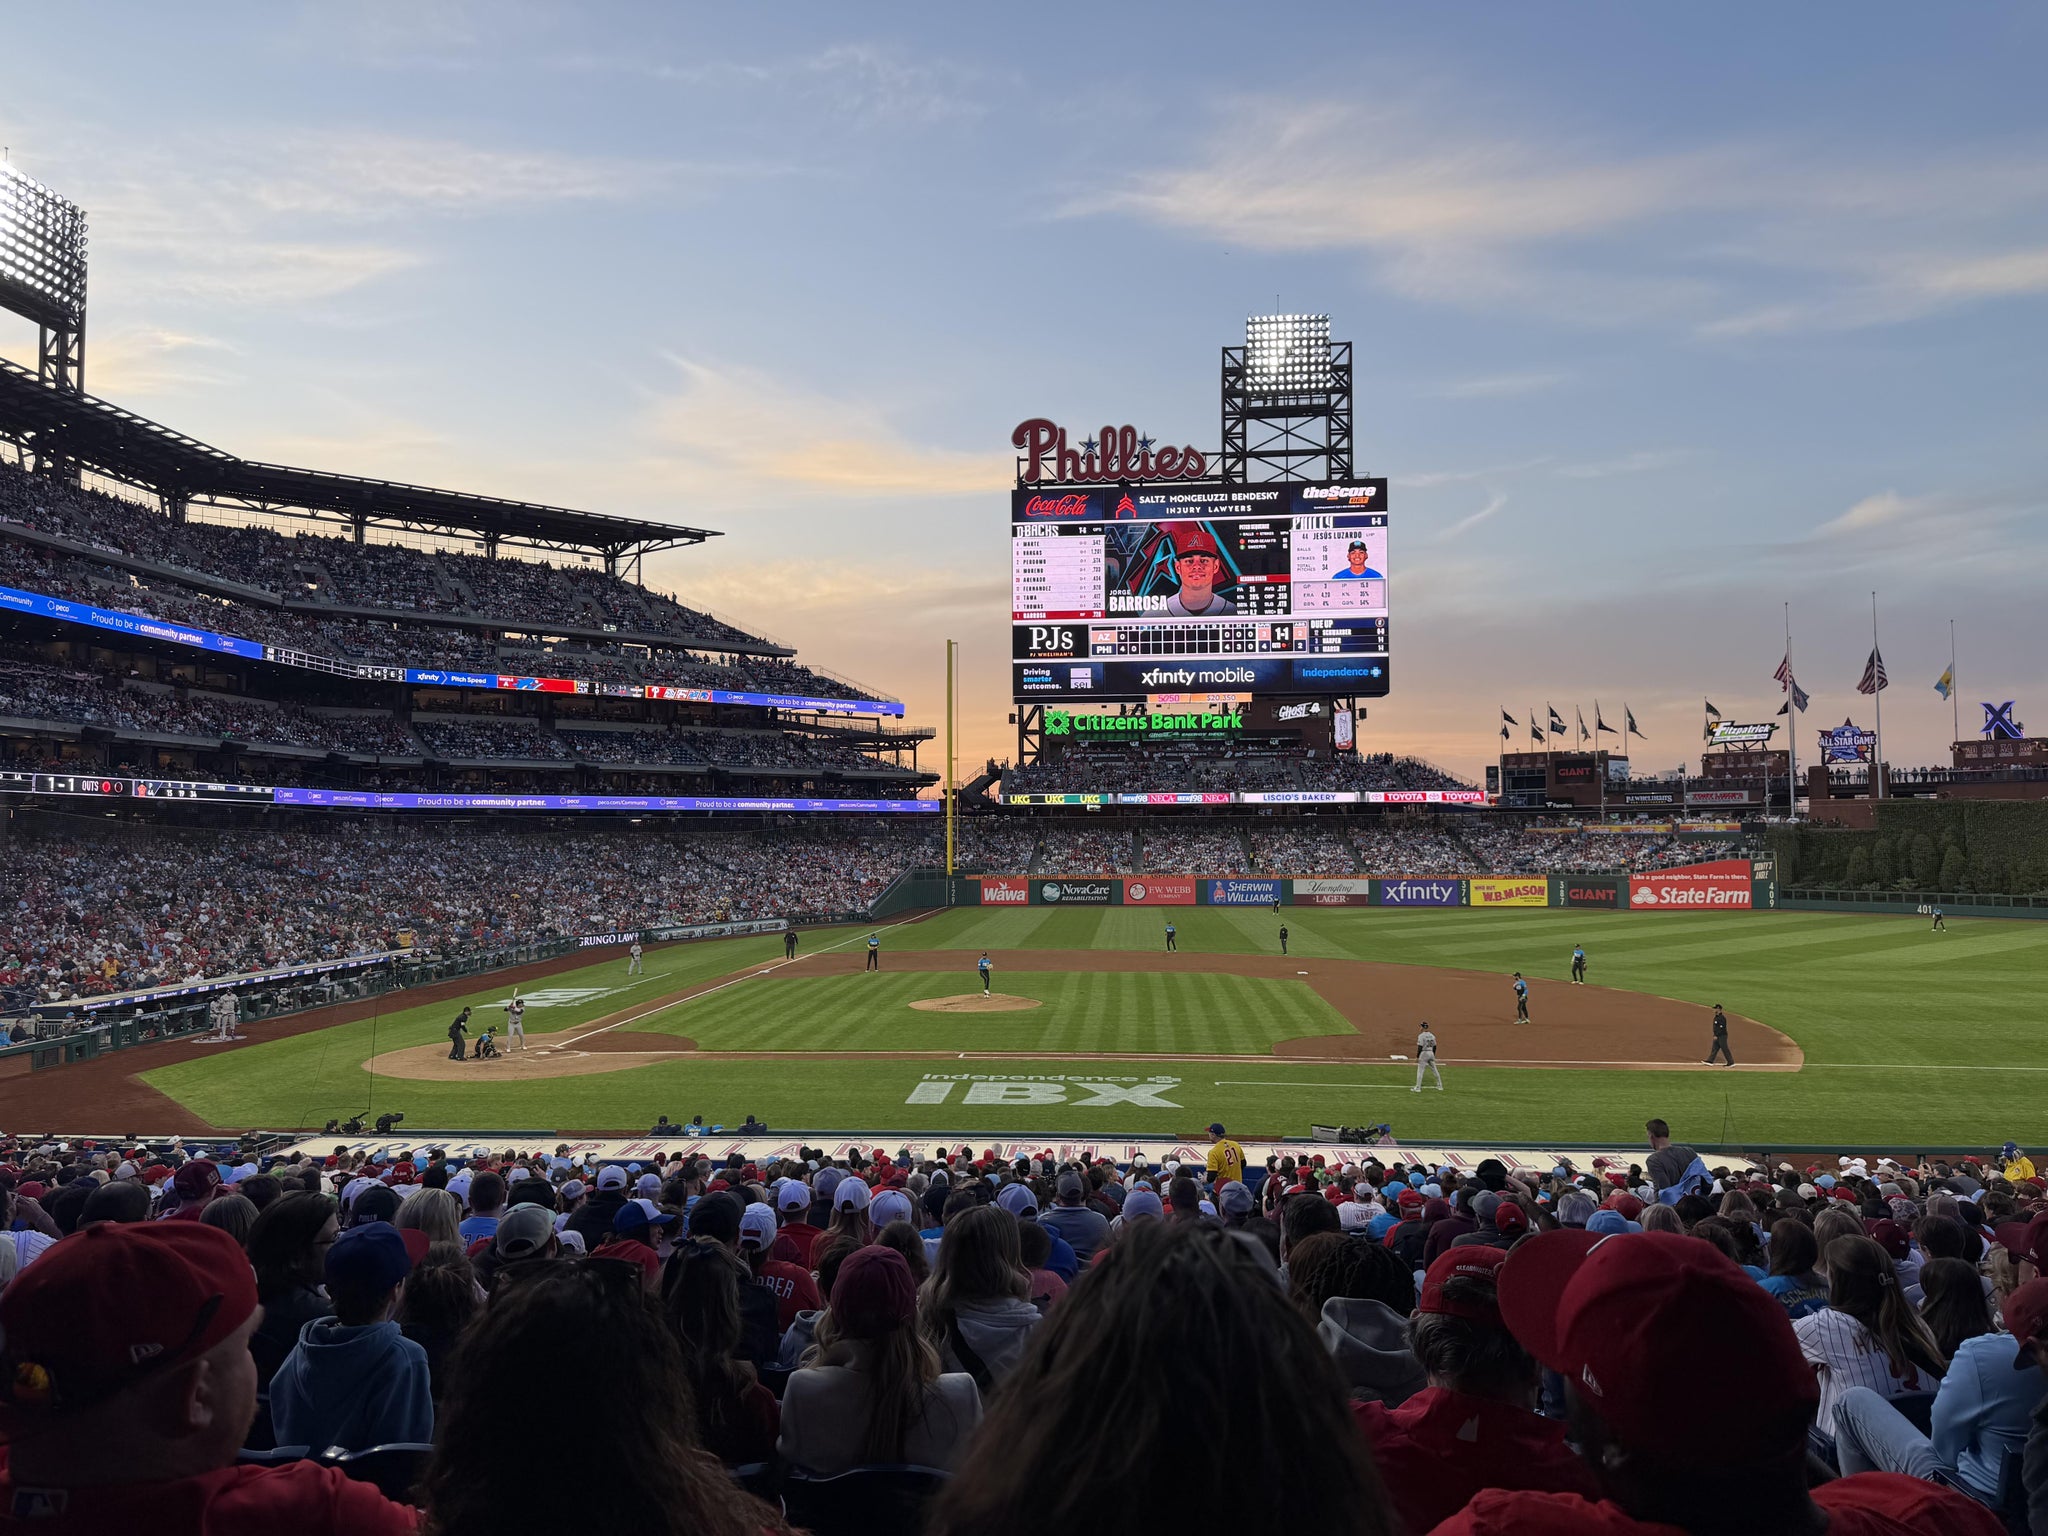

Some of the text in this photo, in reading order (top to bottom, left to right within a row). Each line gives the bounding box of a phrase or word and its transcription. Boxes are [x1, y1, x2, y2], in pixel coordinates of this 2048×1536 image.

[1012, 418, 1206, 483] Phillies
[1139, 492, 1279, 503] SALTZ MONGELUZZI BENDESKY
[1302, 486, 1377, 499] theScore
[1025, 494, 1090, 516] Coca-Cola
[1313, 531, 1362, 540] JESÚS LUZARDO
[55, 604, 70, 613] peco
[1109, 595, 1168, 611] BARROSA
[91, 612, 114, 626] Proud
[115, 618, 123, 627] to
[124, 620, 134, 630] be
[140, 624, 178, 640] community
[179, 630, 204, 644] partner.
[1310, 619, 1323, 629] DUE
[1324, 619, 1333, 628] UP
[1029, 627, 1074, 650] PJs
[1097, 633, 1110, 641] AZ
[1275, 627, 1289, 641] 1-1
[1096, 645, 1112, 654] PHI
[1141, 666, 1255, 686] xfinity mobile
[1302, 666, 1369, 678] Independence
[417, 673, 440, 681] xfinity
[467, 676, 487, 684] Speed
[767, 697, 784, 705] Proud
[805, 700, 835, 709] community
[836, 702, 857, 710] partner.
[1278, 702, 1313, 721] GHOST
[1073, 710, 1243, 731] Citizens Bank Park
[1713, 721, 1770, 737] Fitzpatrick
[1819, 735, 1876, 746] ALL STAR GAME
[1558, 768, 1592, 776] GIANT
[81, 780, 99, 792] OUTS
[1010, 795, 1030, 804] UKG
[1044, 795, 1065, 804] UKG
[1080, 795, 1100, 803] UKG
[1151, 794, 1175, 802] NECA
[1205, 793, 1229, 802] NECA
[1263, 793, 1337, 801] LISCIO'S BAKERY
[1386, 793, 1424, 801] TOYOTA
[1443, 792, 1482, 800] TOYOTA
[417, 797, 547, 807] Proud to be community partner.
[695, 800, 716, 808] Proud
[737, 800, 771, 809] community
[771, 801, 795, 809] partner.
[1553, 801, 1573, 809] Fanatics
[1061, 884, 1110, 895] NovaCare
[1227, 881, 1273, 892] SHERWIN
[1307, 881, 1354, 893] Yuengling
[1385, 881, 1453, 902] xfinity
[983, 887, 1026, 901] Wawa
[1227, 892, 1274, 902] WILLIAMS
[1315, 895, 1347, 903] LAGER
[1568, 888, 1617, 900] GIANT
[1917, 905, 1932, 914] 401
[578, 932, 635, 947] GRUNGO LAW
[922, 1073, 1139, 1083] Independence
[904, 1081, 1184, 1108] IBX
[1224, 1147, 1241, 1167] 21
